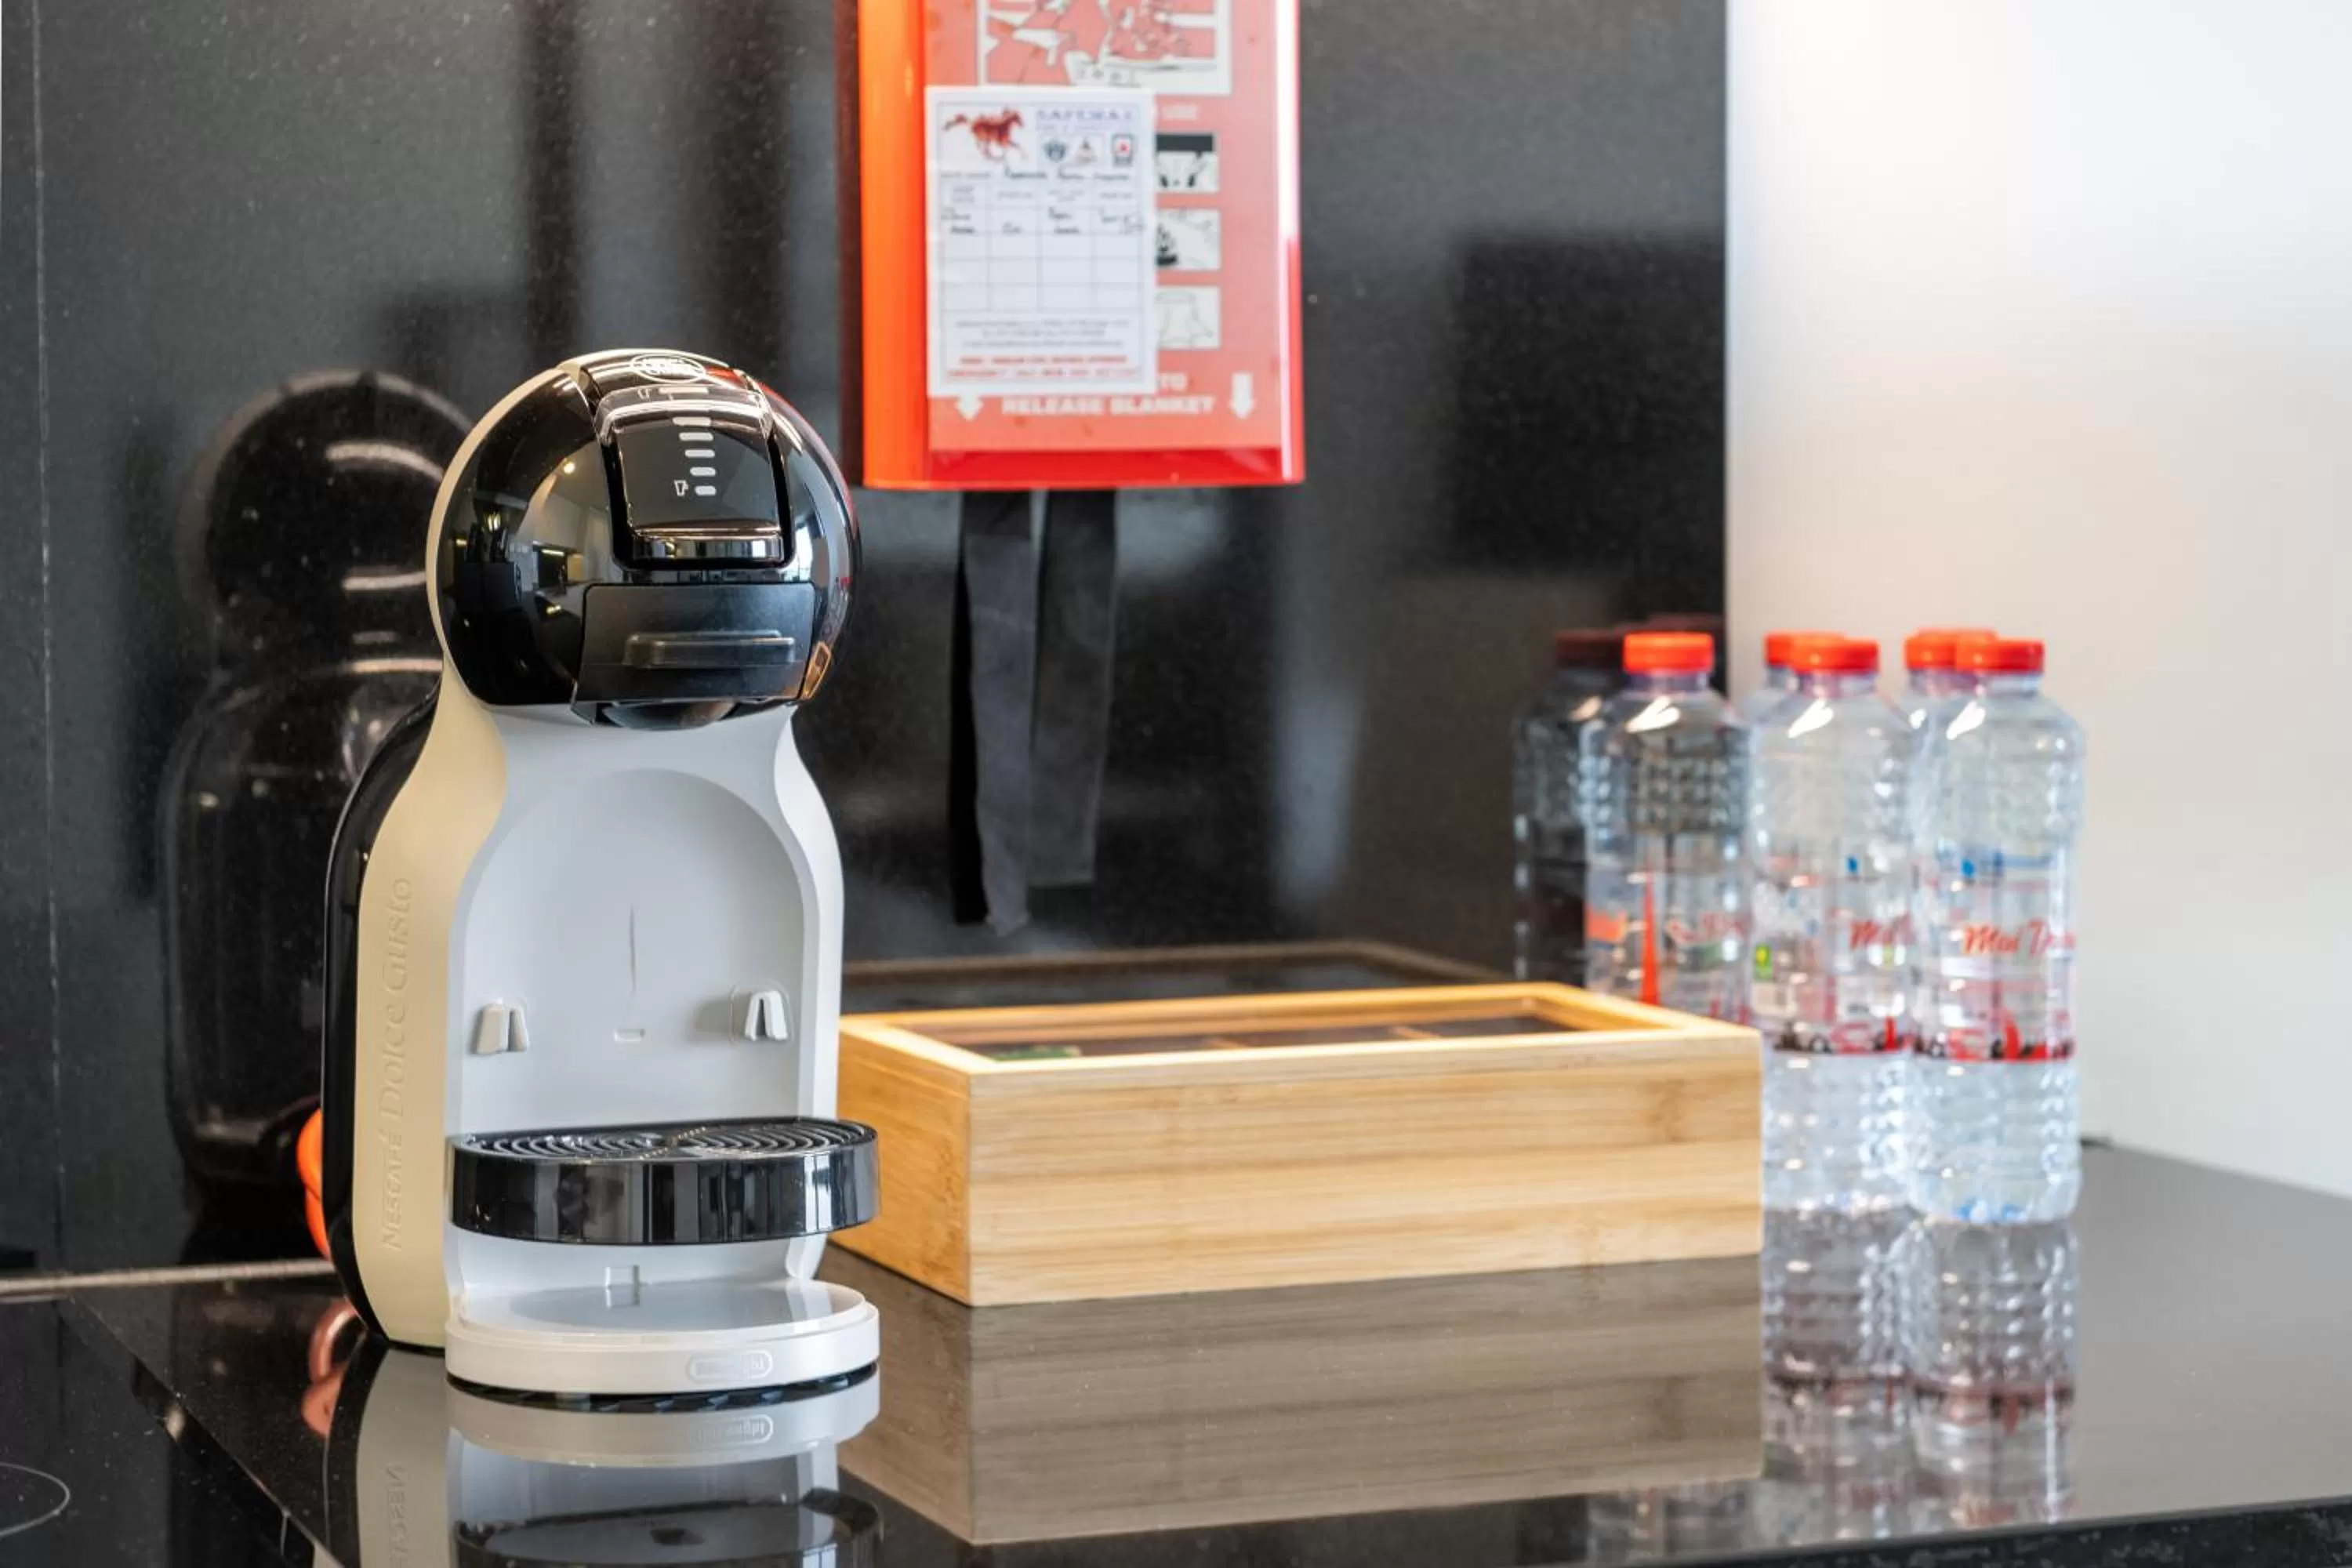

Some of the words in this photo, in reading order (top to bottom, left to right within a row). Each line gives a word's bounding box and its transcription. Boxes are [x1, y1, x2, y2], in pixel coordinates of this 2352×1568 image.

[1002, 396, 1102, 415] RELEASE
[1110, 396, 1214, 415] BLANKET
[382, 877, 412, 992] Gusto
